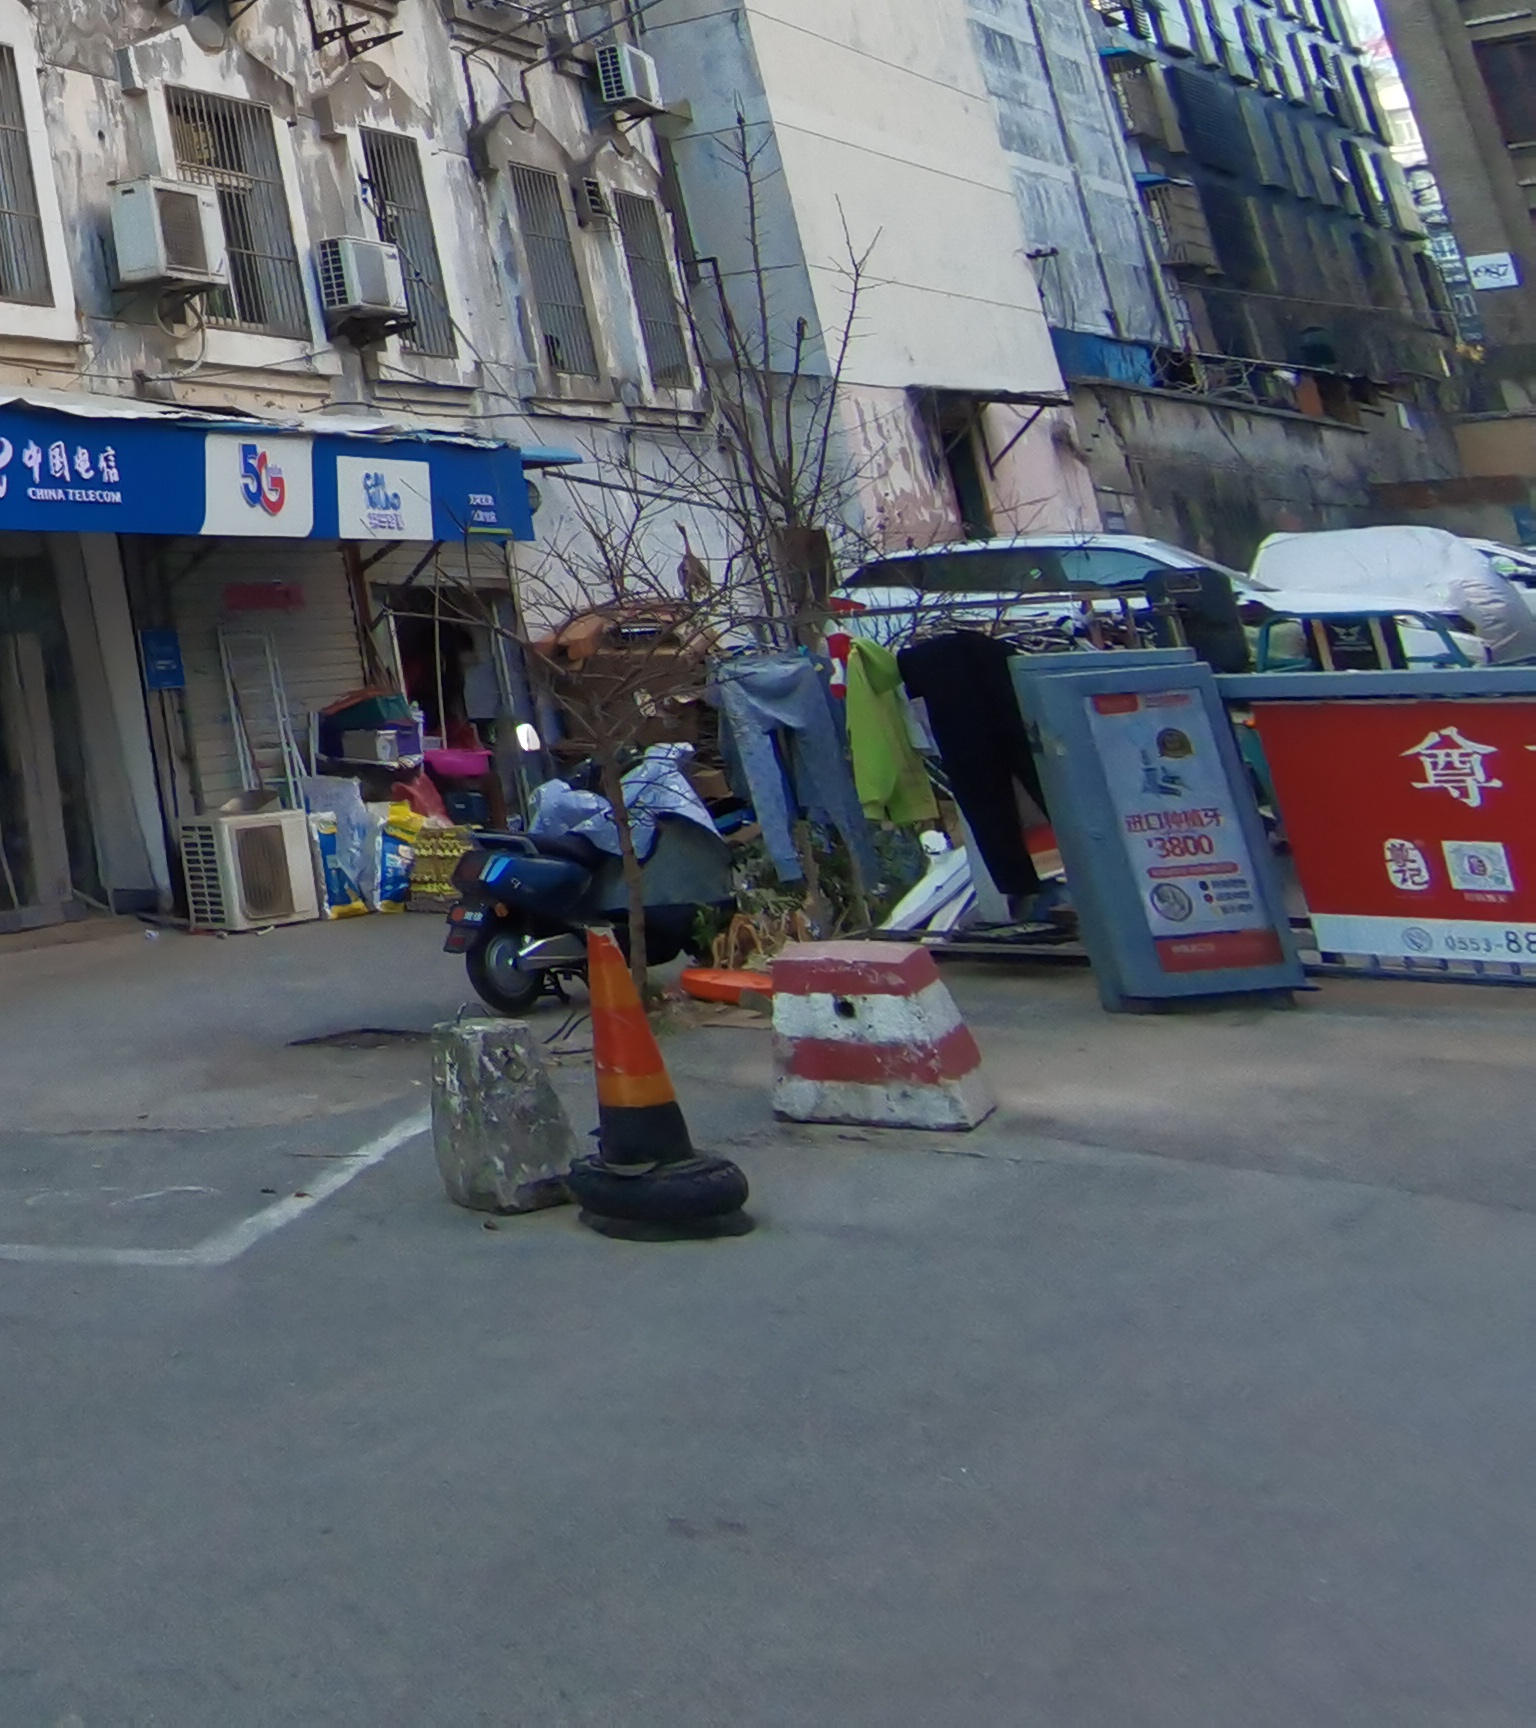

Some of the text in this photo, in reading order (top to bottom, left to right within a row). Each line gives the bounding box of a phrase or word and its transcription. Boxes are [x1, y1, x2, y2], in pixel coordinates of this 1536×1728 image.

[22, 439, 120, 485] 中国电信
[239, 443, 286, 515] 5G
[28, 487, 123, 504] CHINA TELECOM
